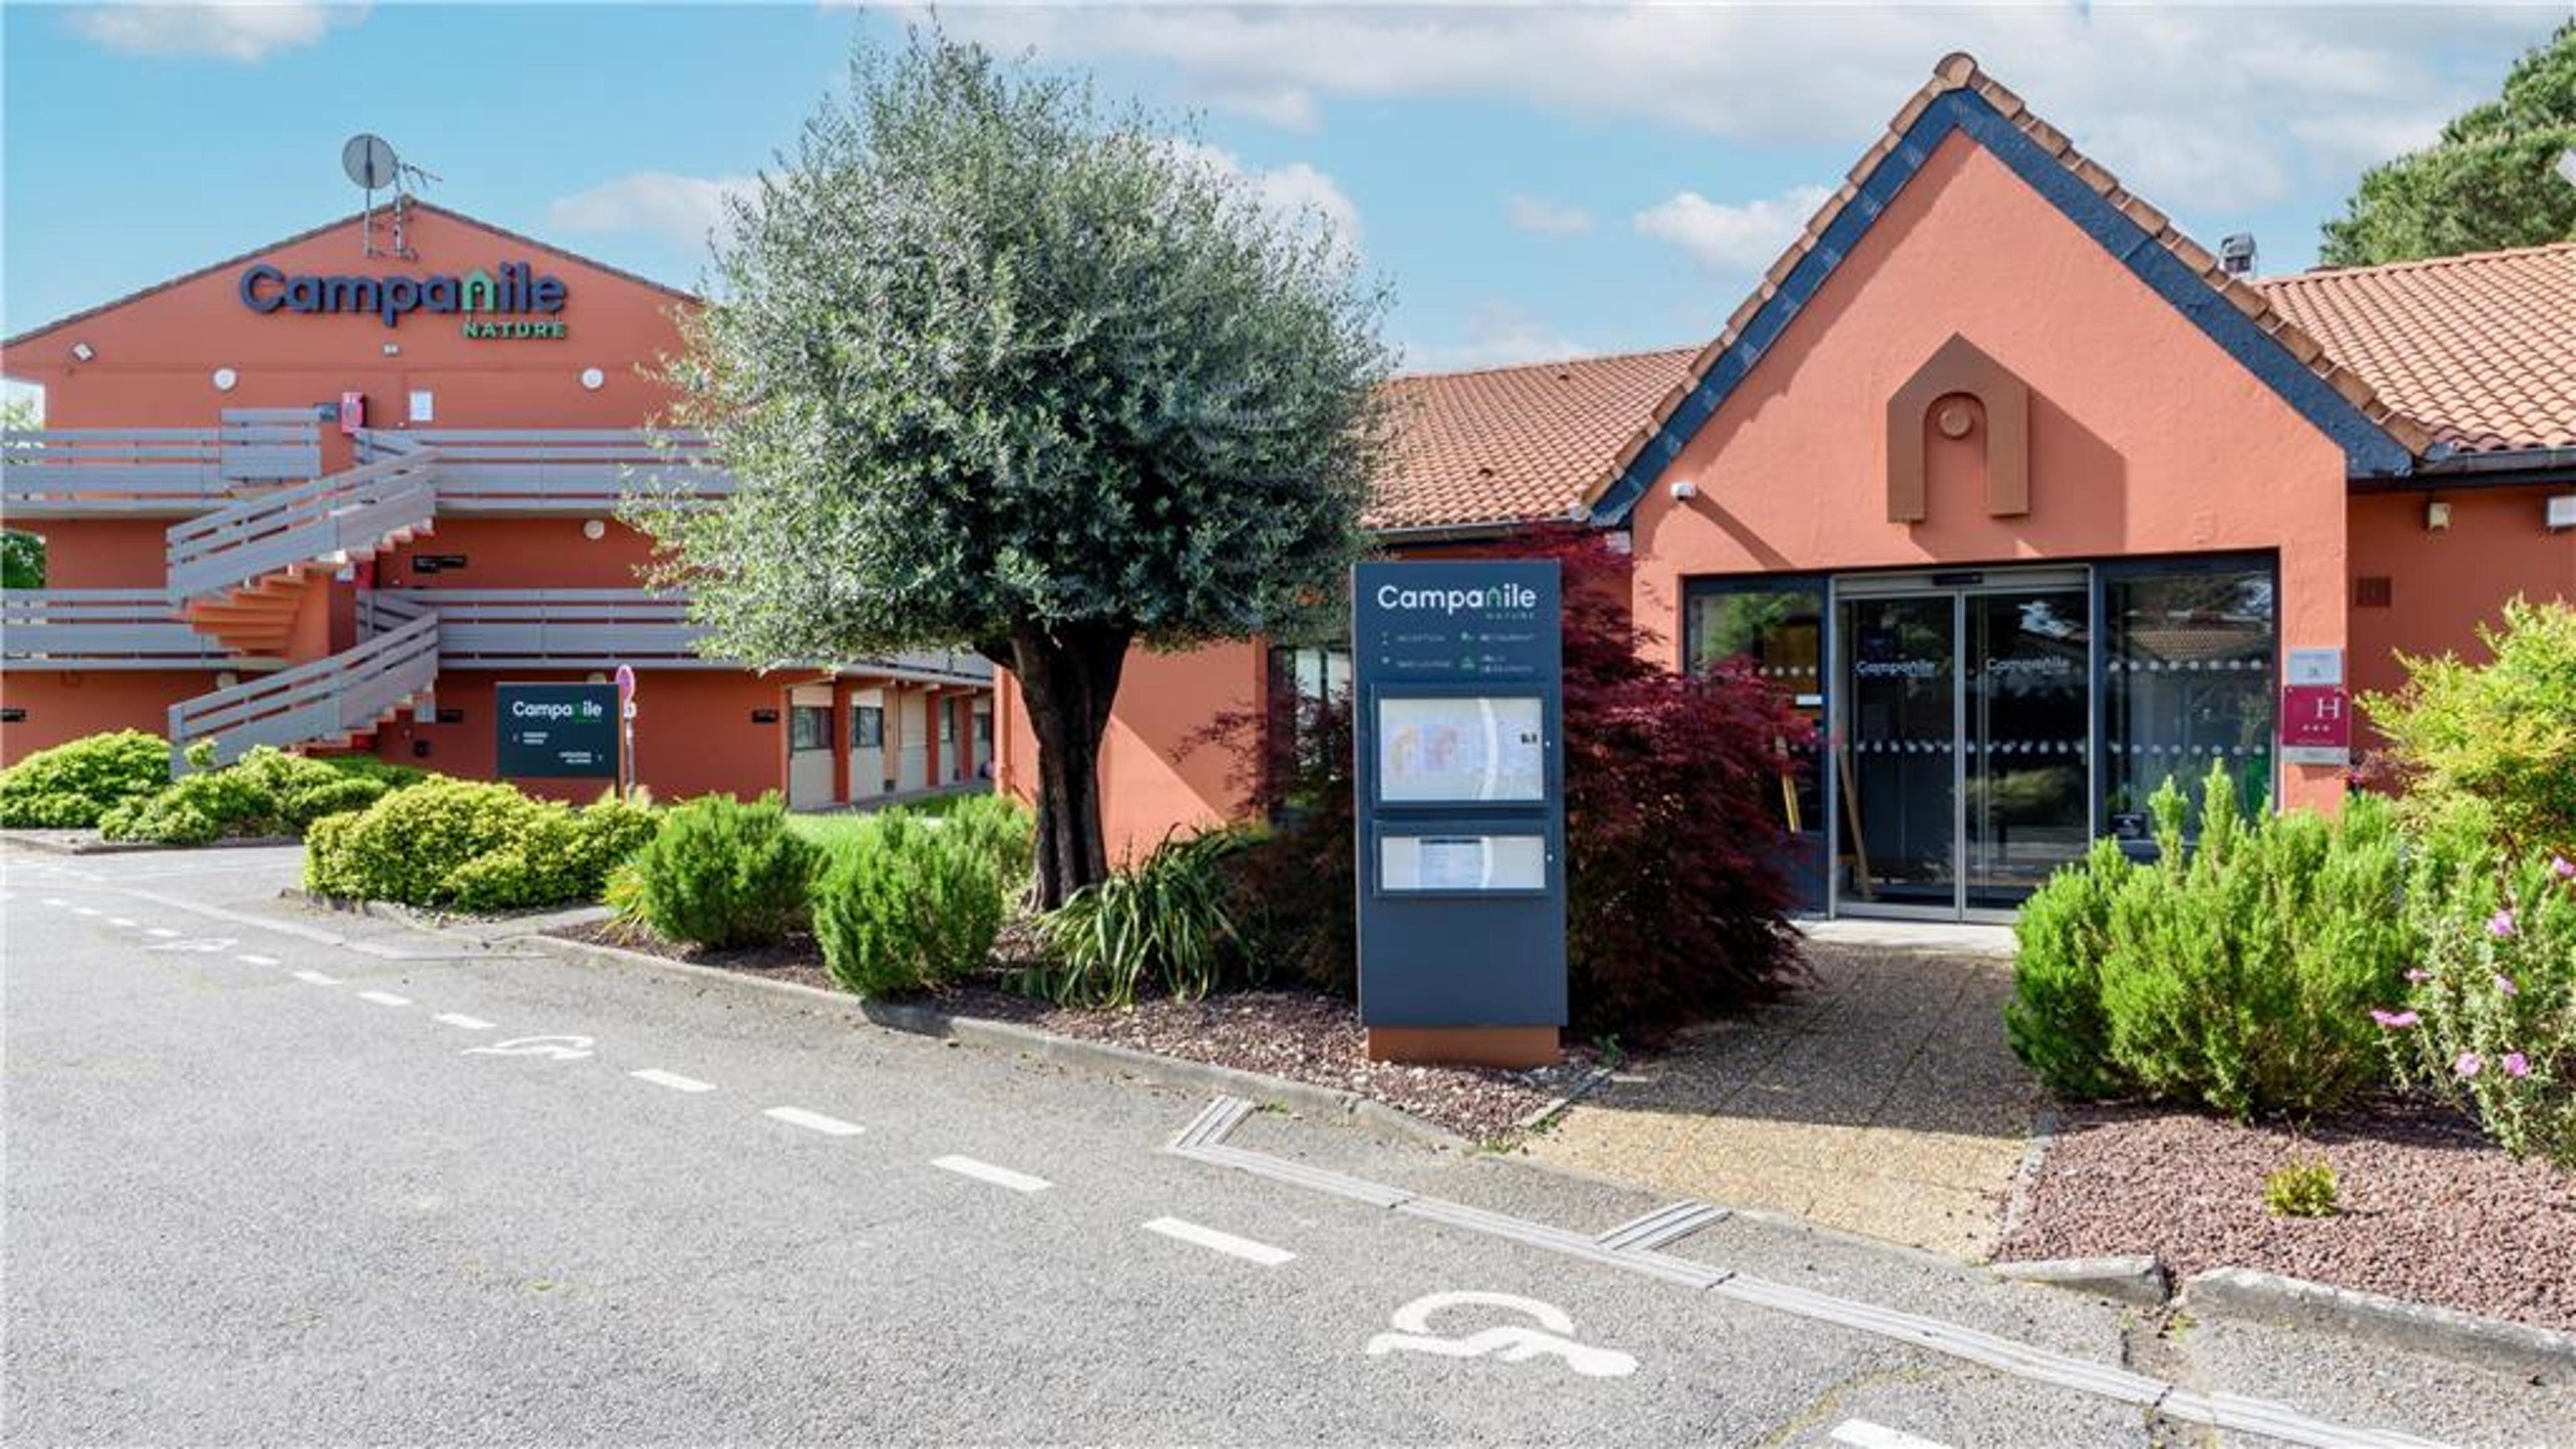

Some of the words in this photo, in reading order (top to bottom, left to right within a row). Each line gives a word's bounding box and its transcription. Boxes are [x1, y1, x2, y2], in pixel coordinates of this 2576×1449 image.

[240, 262, 567, 327] Campanile
[463, 321, 566, 338] NATURE
[1378, 583, 1537, 615] Campanile
[2316, 697, 2341, 719] H
